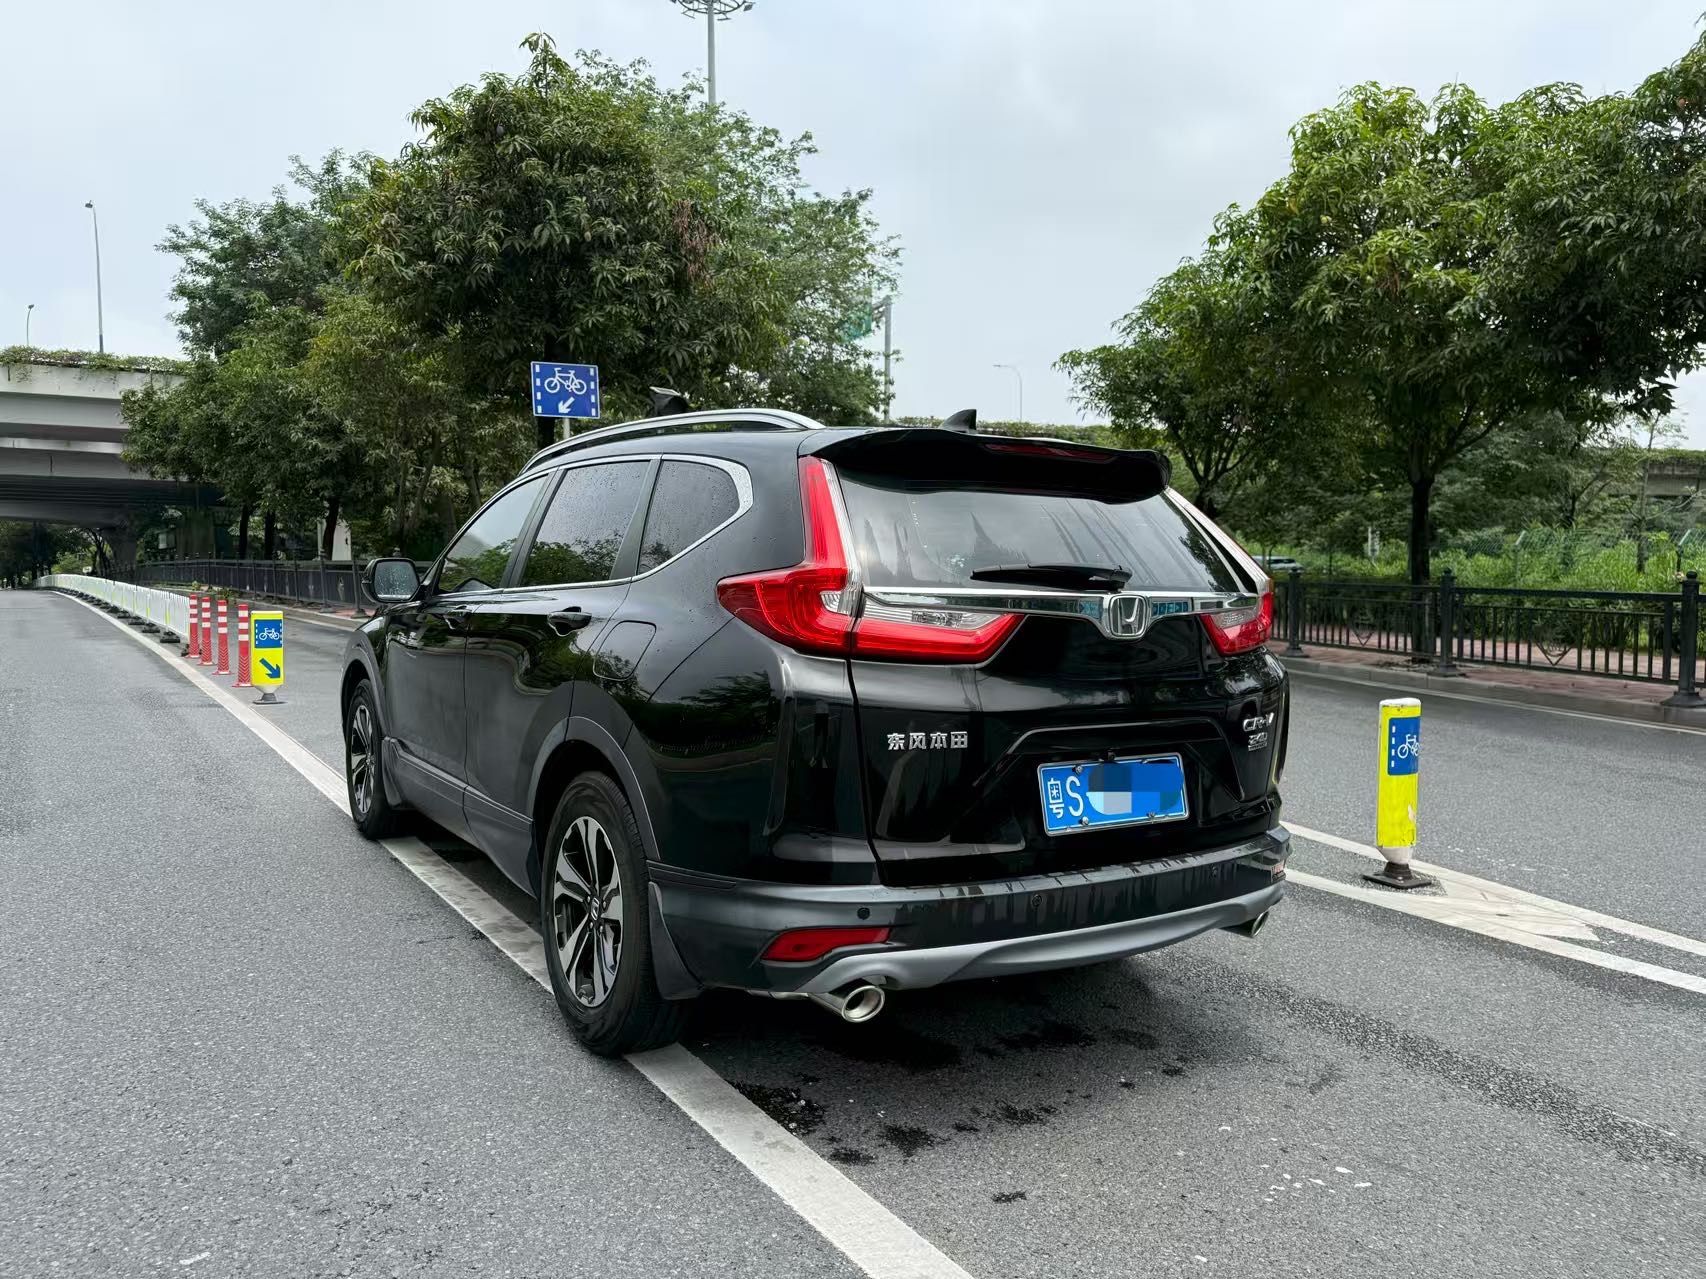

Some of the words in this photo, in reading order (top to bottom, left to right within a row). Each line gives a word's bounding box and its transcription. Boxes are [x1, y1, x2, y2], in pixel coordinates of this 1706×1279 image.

[1243, 712, 1275, 732] CR-V
[887, 731, 968, 751] 东风本田
